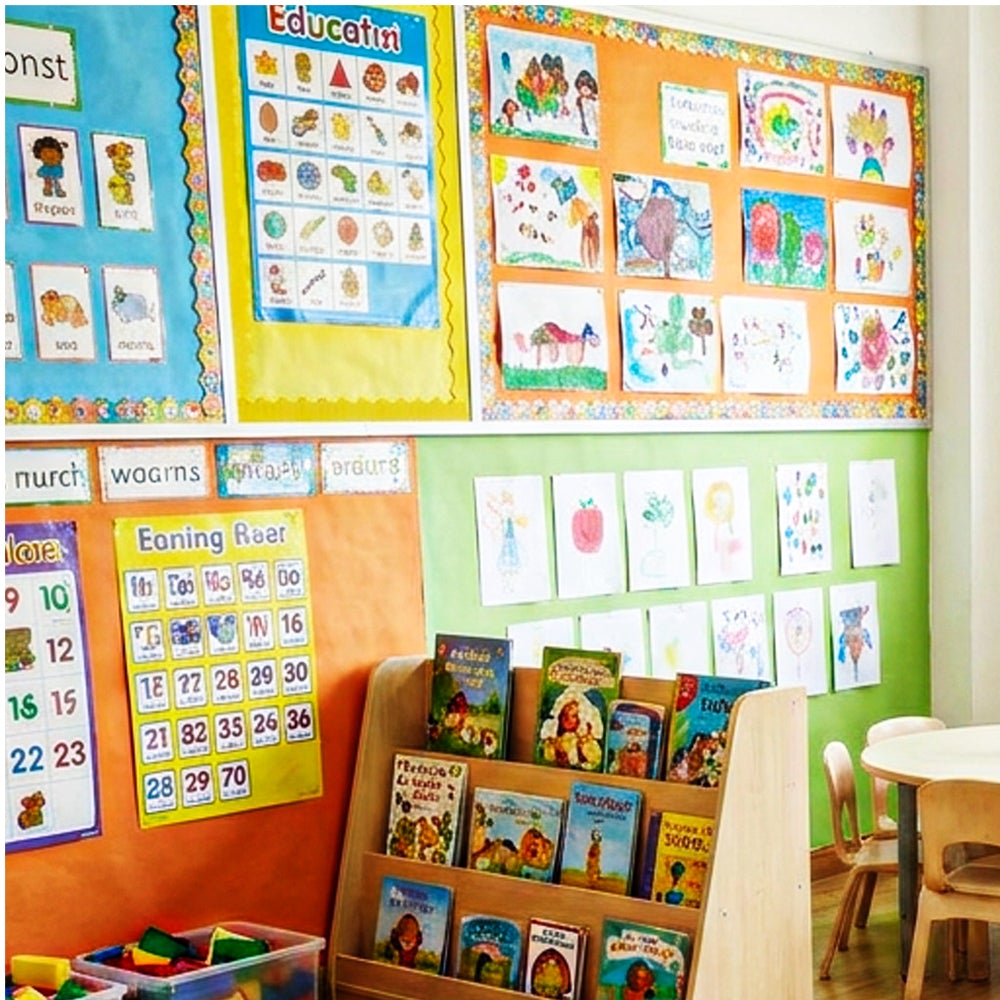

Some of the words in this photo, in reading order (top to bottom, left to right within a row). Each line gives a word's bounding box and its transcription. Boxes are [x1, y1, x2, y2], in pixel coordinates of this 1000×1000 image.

[39, 585, 69, 610] 10
[282, 613, 303, 634] 16
[46, 637, 74, 663] 12
[284, 662, 308, 683] 30
[287, 709, 311, 730] 36
[11, 746, 44, 774] 22
[54, 741, 86, 768] 23
[147, 776, 173, 799] 28
[185, 771, 210, 792] 29
[221, 765, 246, 787] 70
